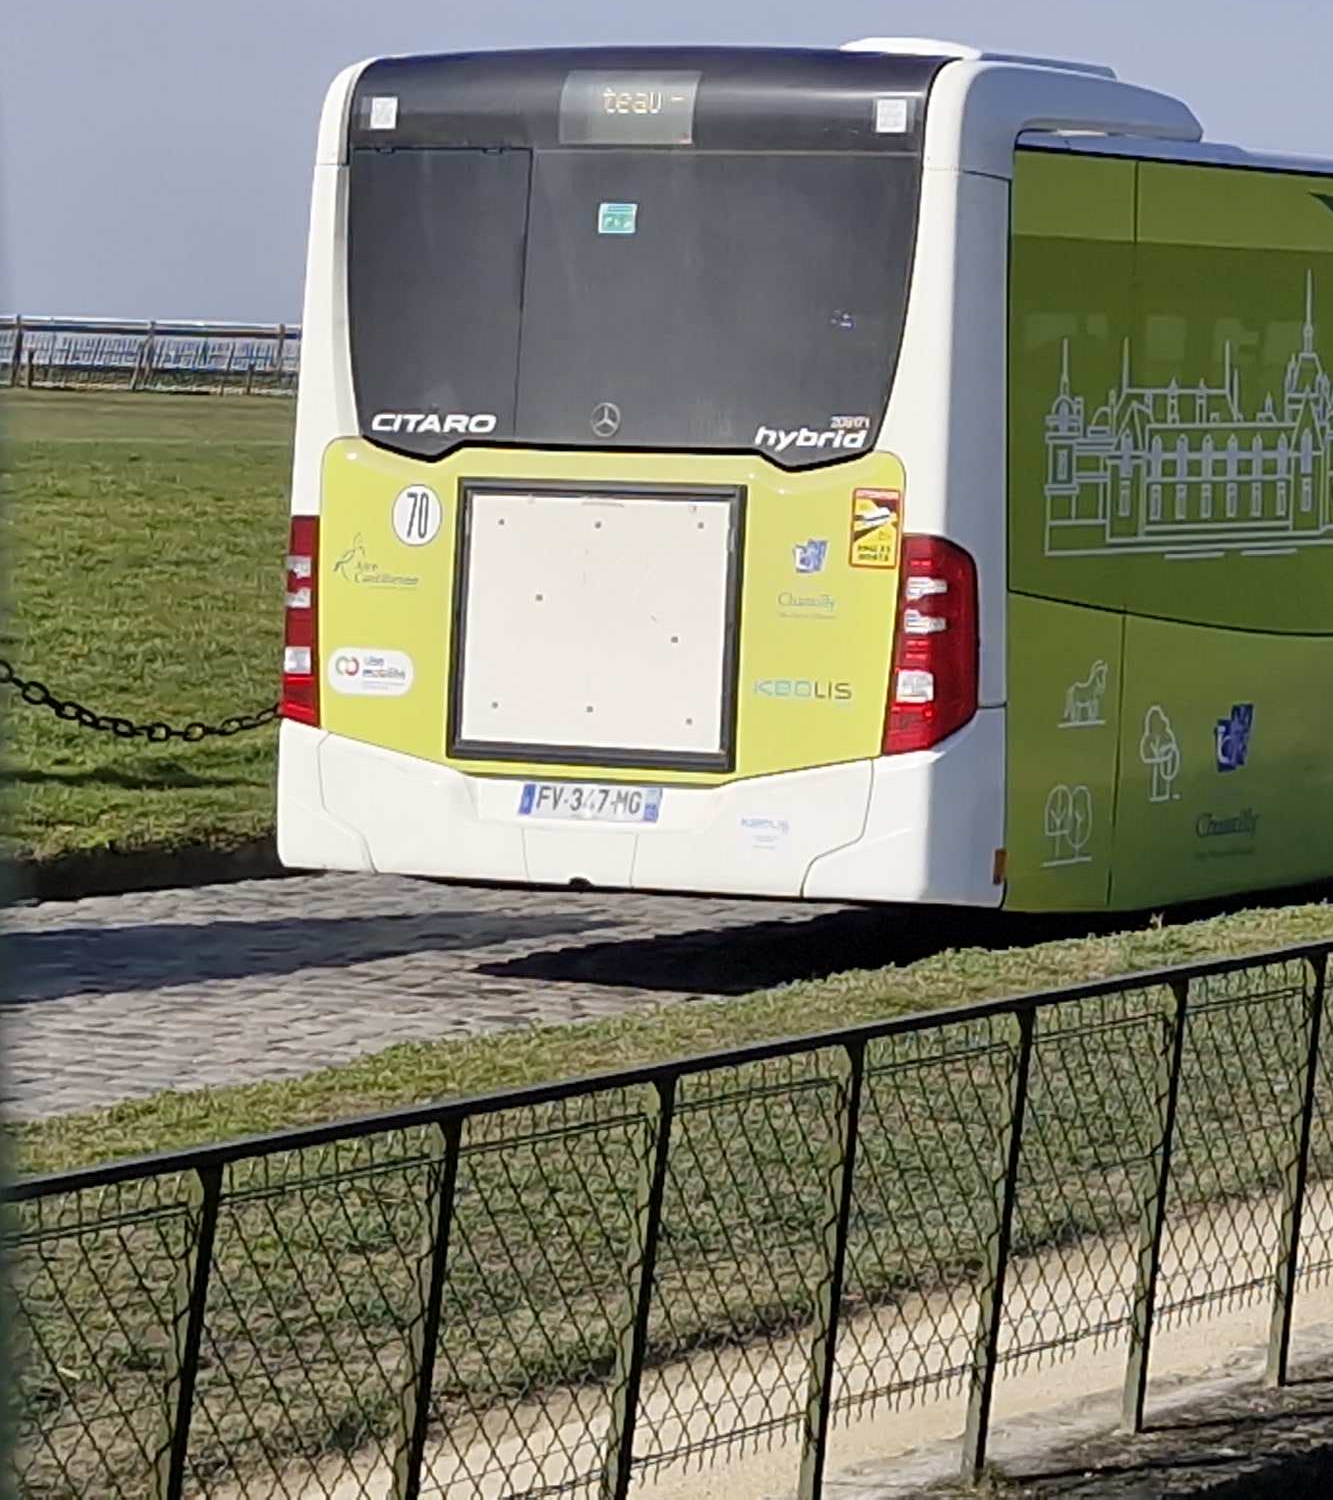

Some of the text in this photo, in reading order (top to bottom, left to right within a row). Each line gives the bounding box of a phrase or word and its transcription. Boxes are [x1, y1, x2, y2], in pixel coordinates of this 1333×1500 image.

[371, 413, 497, 433] CITARO
[754, 425, 868, 452] hybrid
[406, 491, 430, 539] 70
